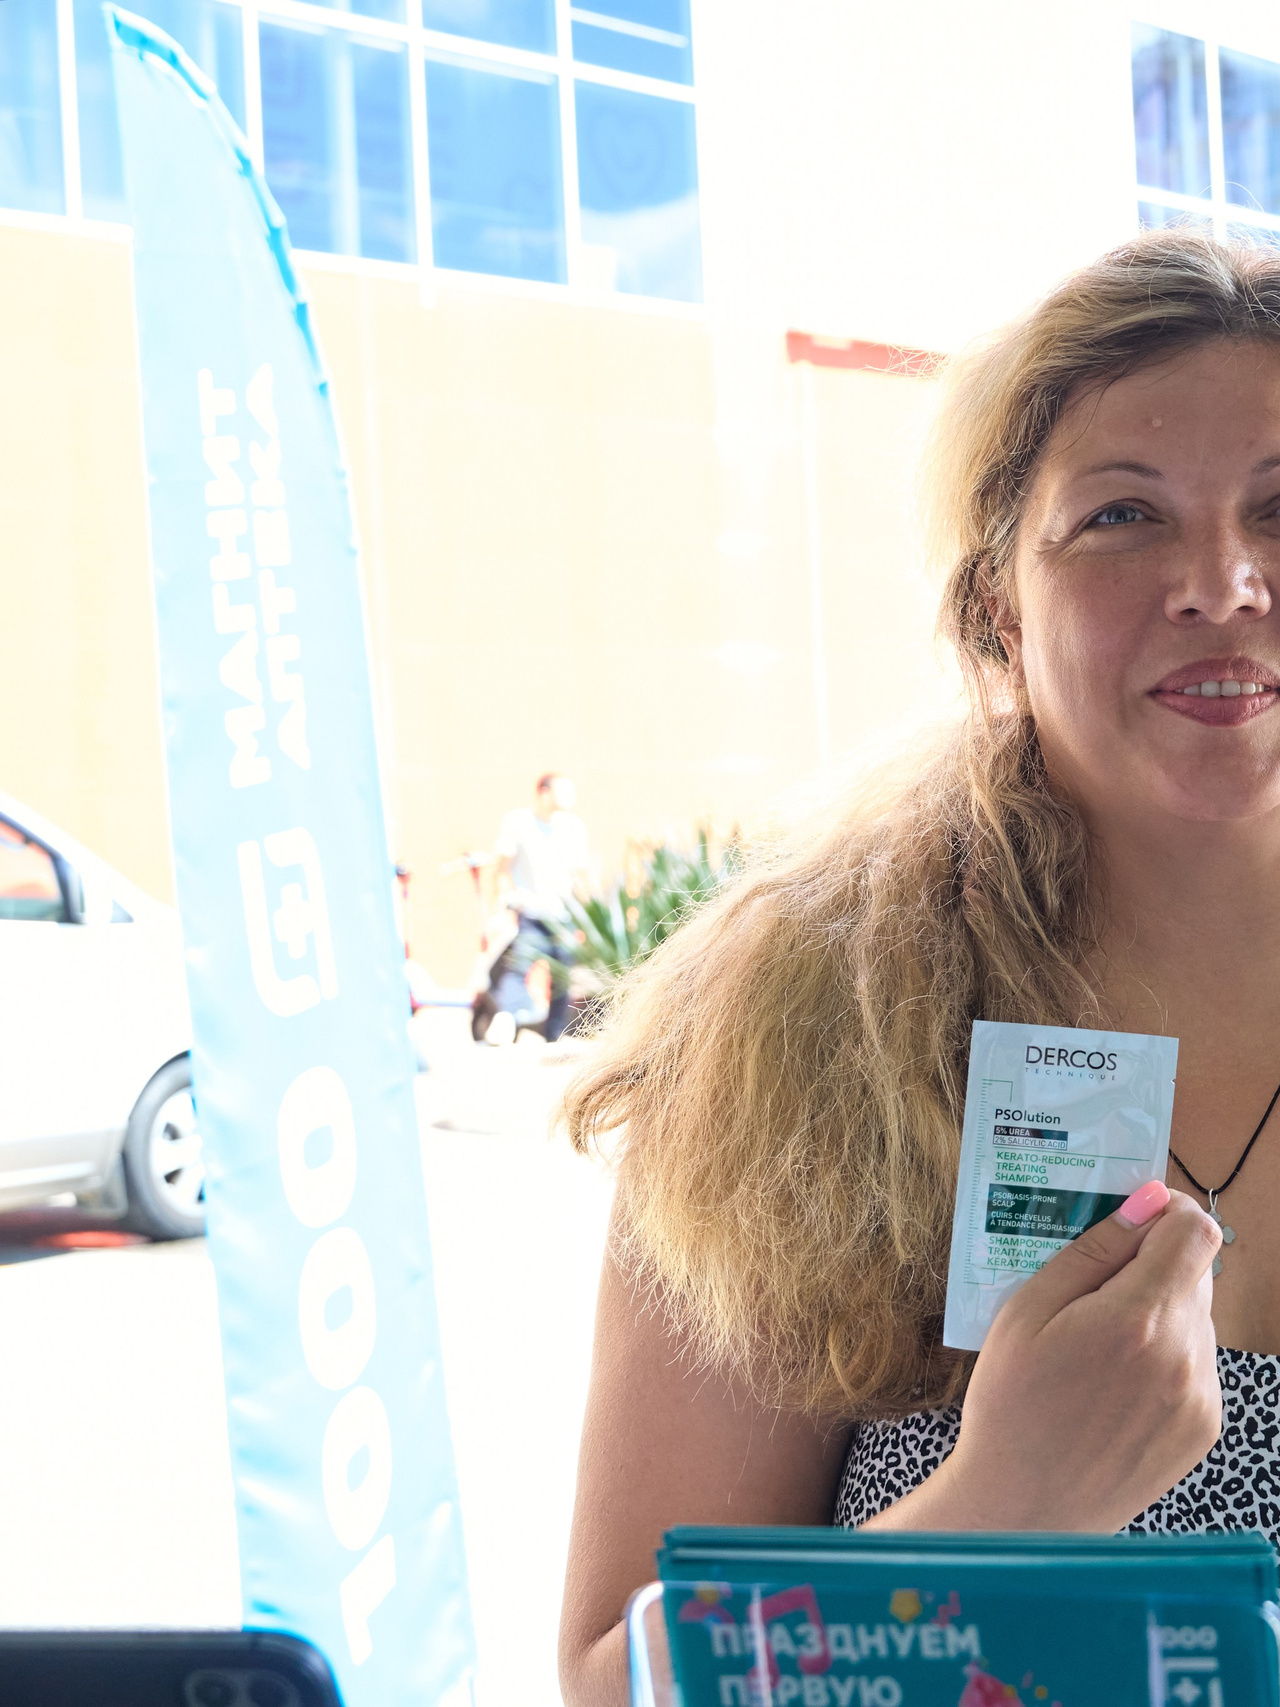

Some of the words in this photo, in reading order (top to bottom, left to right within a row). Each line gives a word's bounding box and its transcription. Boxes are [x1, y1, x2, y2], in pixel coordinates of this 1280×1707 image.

[246, 363, 310, 770] АПТЕКА
[198, 368, 272, 788] МАГНИТ
[1026, 1045, 1118, 1071] DERCOS
[1025, 1067, 1117, 1081] TECHNIQUE
[994, 1108, 1061, 1125] PSOlution
[995, 1126, 1007, 1135] 5%
[1009, 1127, 1031, 1137] UREA
[994, 1135, 1006, 1144] 2%
[1007, 1136, 1046, 1147] SALICYLIC
[1047, 1140, 1066, 1149] ACID
[996, 1151, 1096, 1168] KERATO-REDUCING
[996, 1161, 1047, 1174] TREATING
[994, 1172, 1049, 1185] SHAMPOO
[992, 1199, 1016, 1208] SCALP
[993, 1191, 1058, 1204] PSORIASIS-PRONE
[991, 1211, 1013, 1220] CUIRS
[1014, 1213, 1052, 1223] CHEVELUS
[997, 1219, 1036, 1229] TENDANCE
[1037, 1222, 1084, 1234] PSORIASIQUE
[989, 1235, 1062, 1250] SHAMPOOING
[988, 1246, 1038, 1259] TRAITANT
[711, 1622, 981, 1662] ПРАЗДНУЕМ
[718, 1674, 903, 1707] ПРВУЮ
